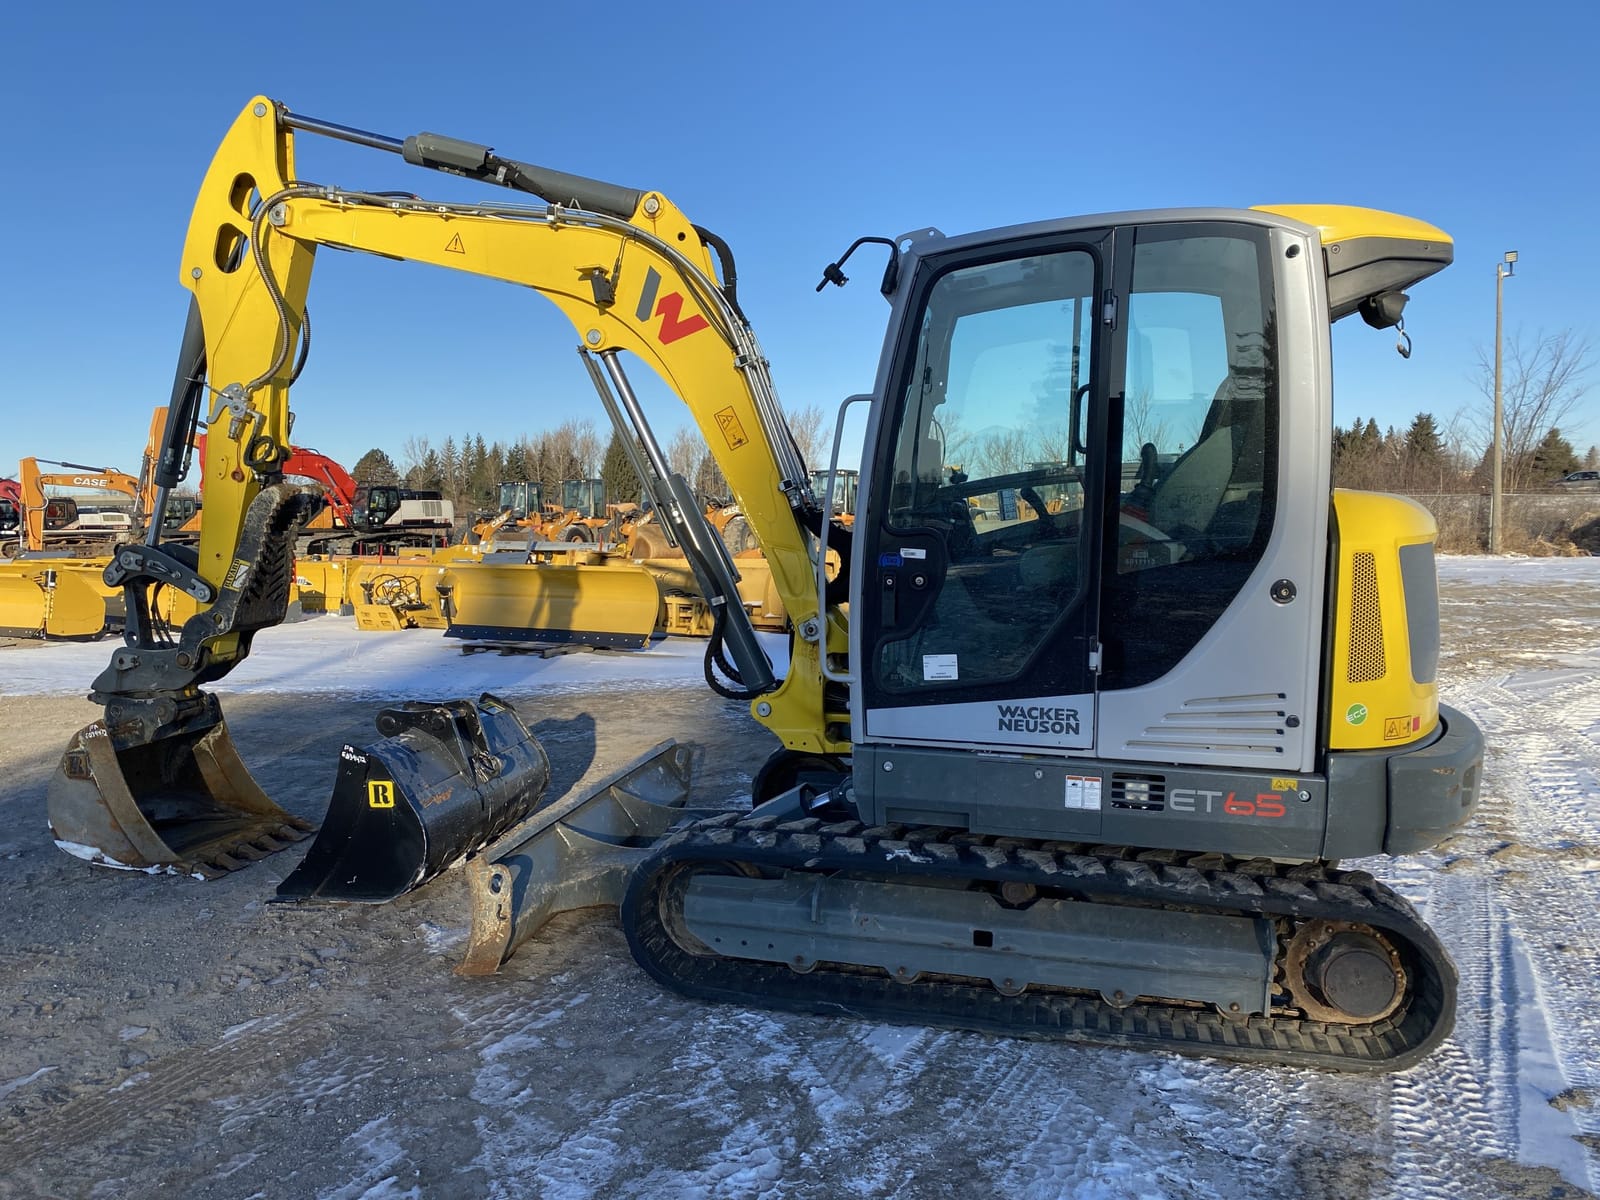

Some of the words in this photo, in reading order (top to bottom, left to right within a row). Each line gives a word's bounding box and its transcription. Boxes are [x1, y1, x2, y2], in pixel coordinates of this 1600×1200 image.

[73, 477, 108, 487] CASE
[223, 559, 240, 588] RIVARD
[997, 704, 1080, 722] WACKER
[1346, 707, 1367, 723] ECO
[998, 718, 1080, 735] NEUSON
[372, 784, 391, 804] R
